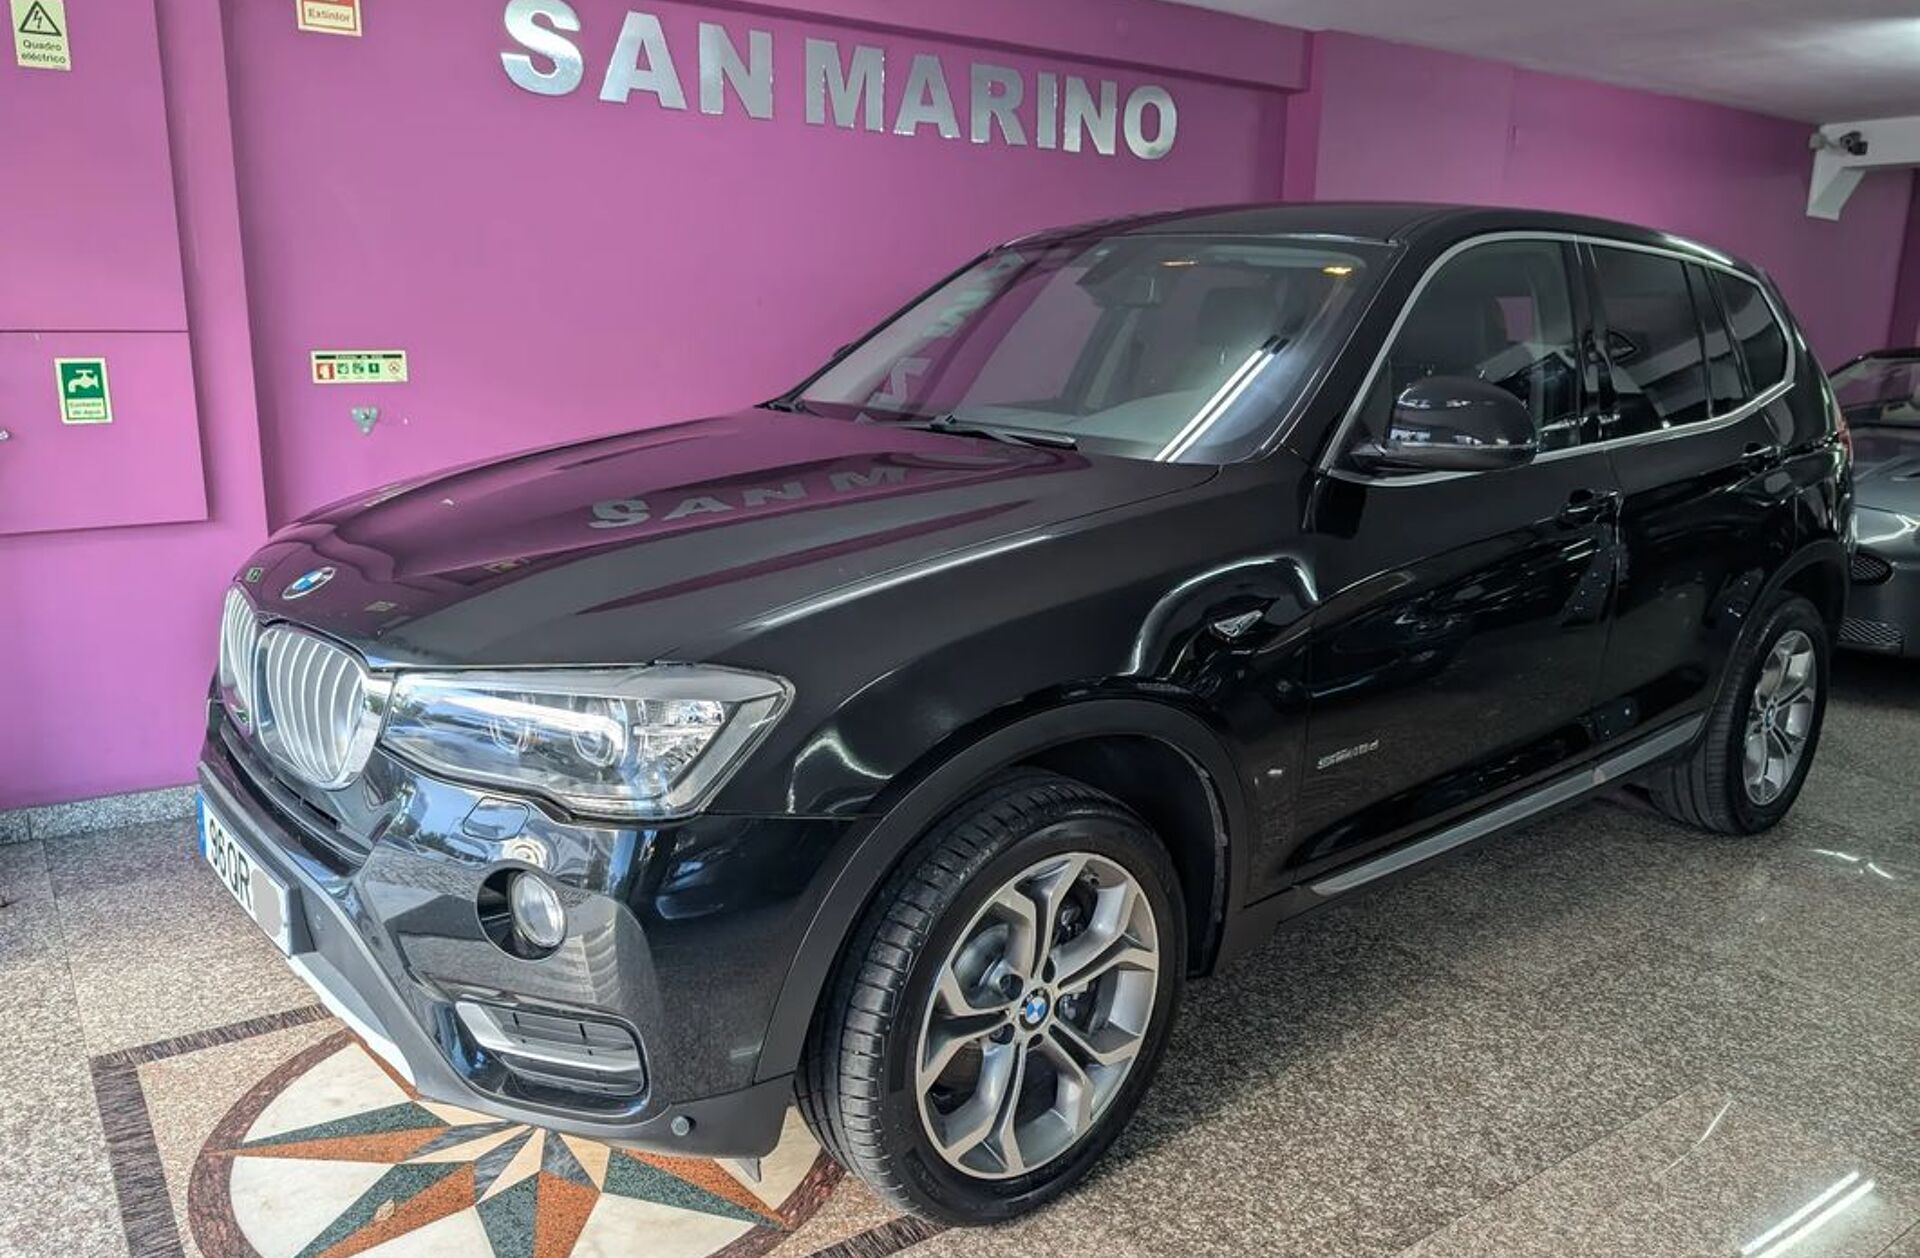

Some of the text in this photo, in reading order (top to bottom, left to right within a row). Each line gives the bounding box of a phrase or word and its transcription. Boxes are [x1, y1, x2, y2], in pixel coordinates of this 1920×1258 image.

[23, 39, 62, 51] Quadro
[500, 0, 1179, 160] SAN MARINO
